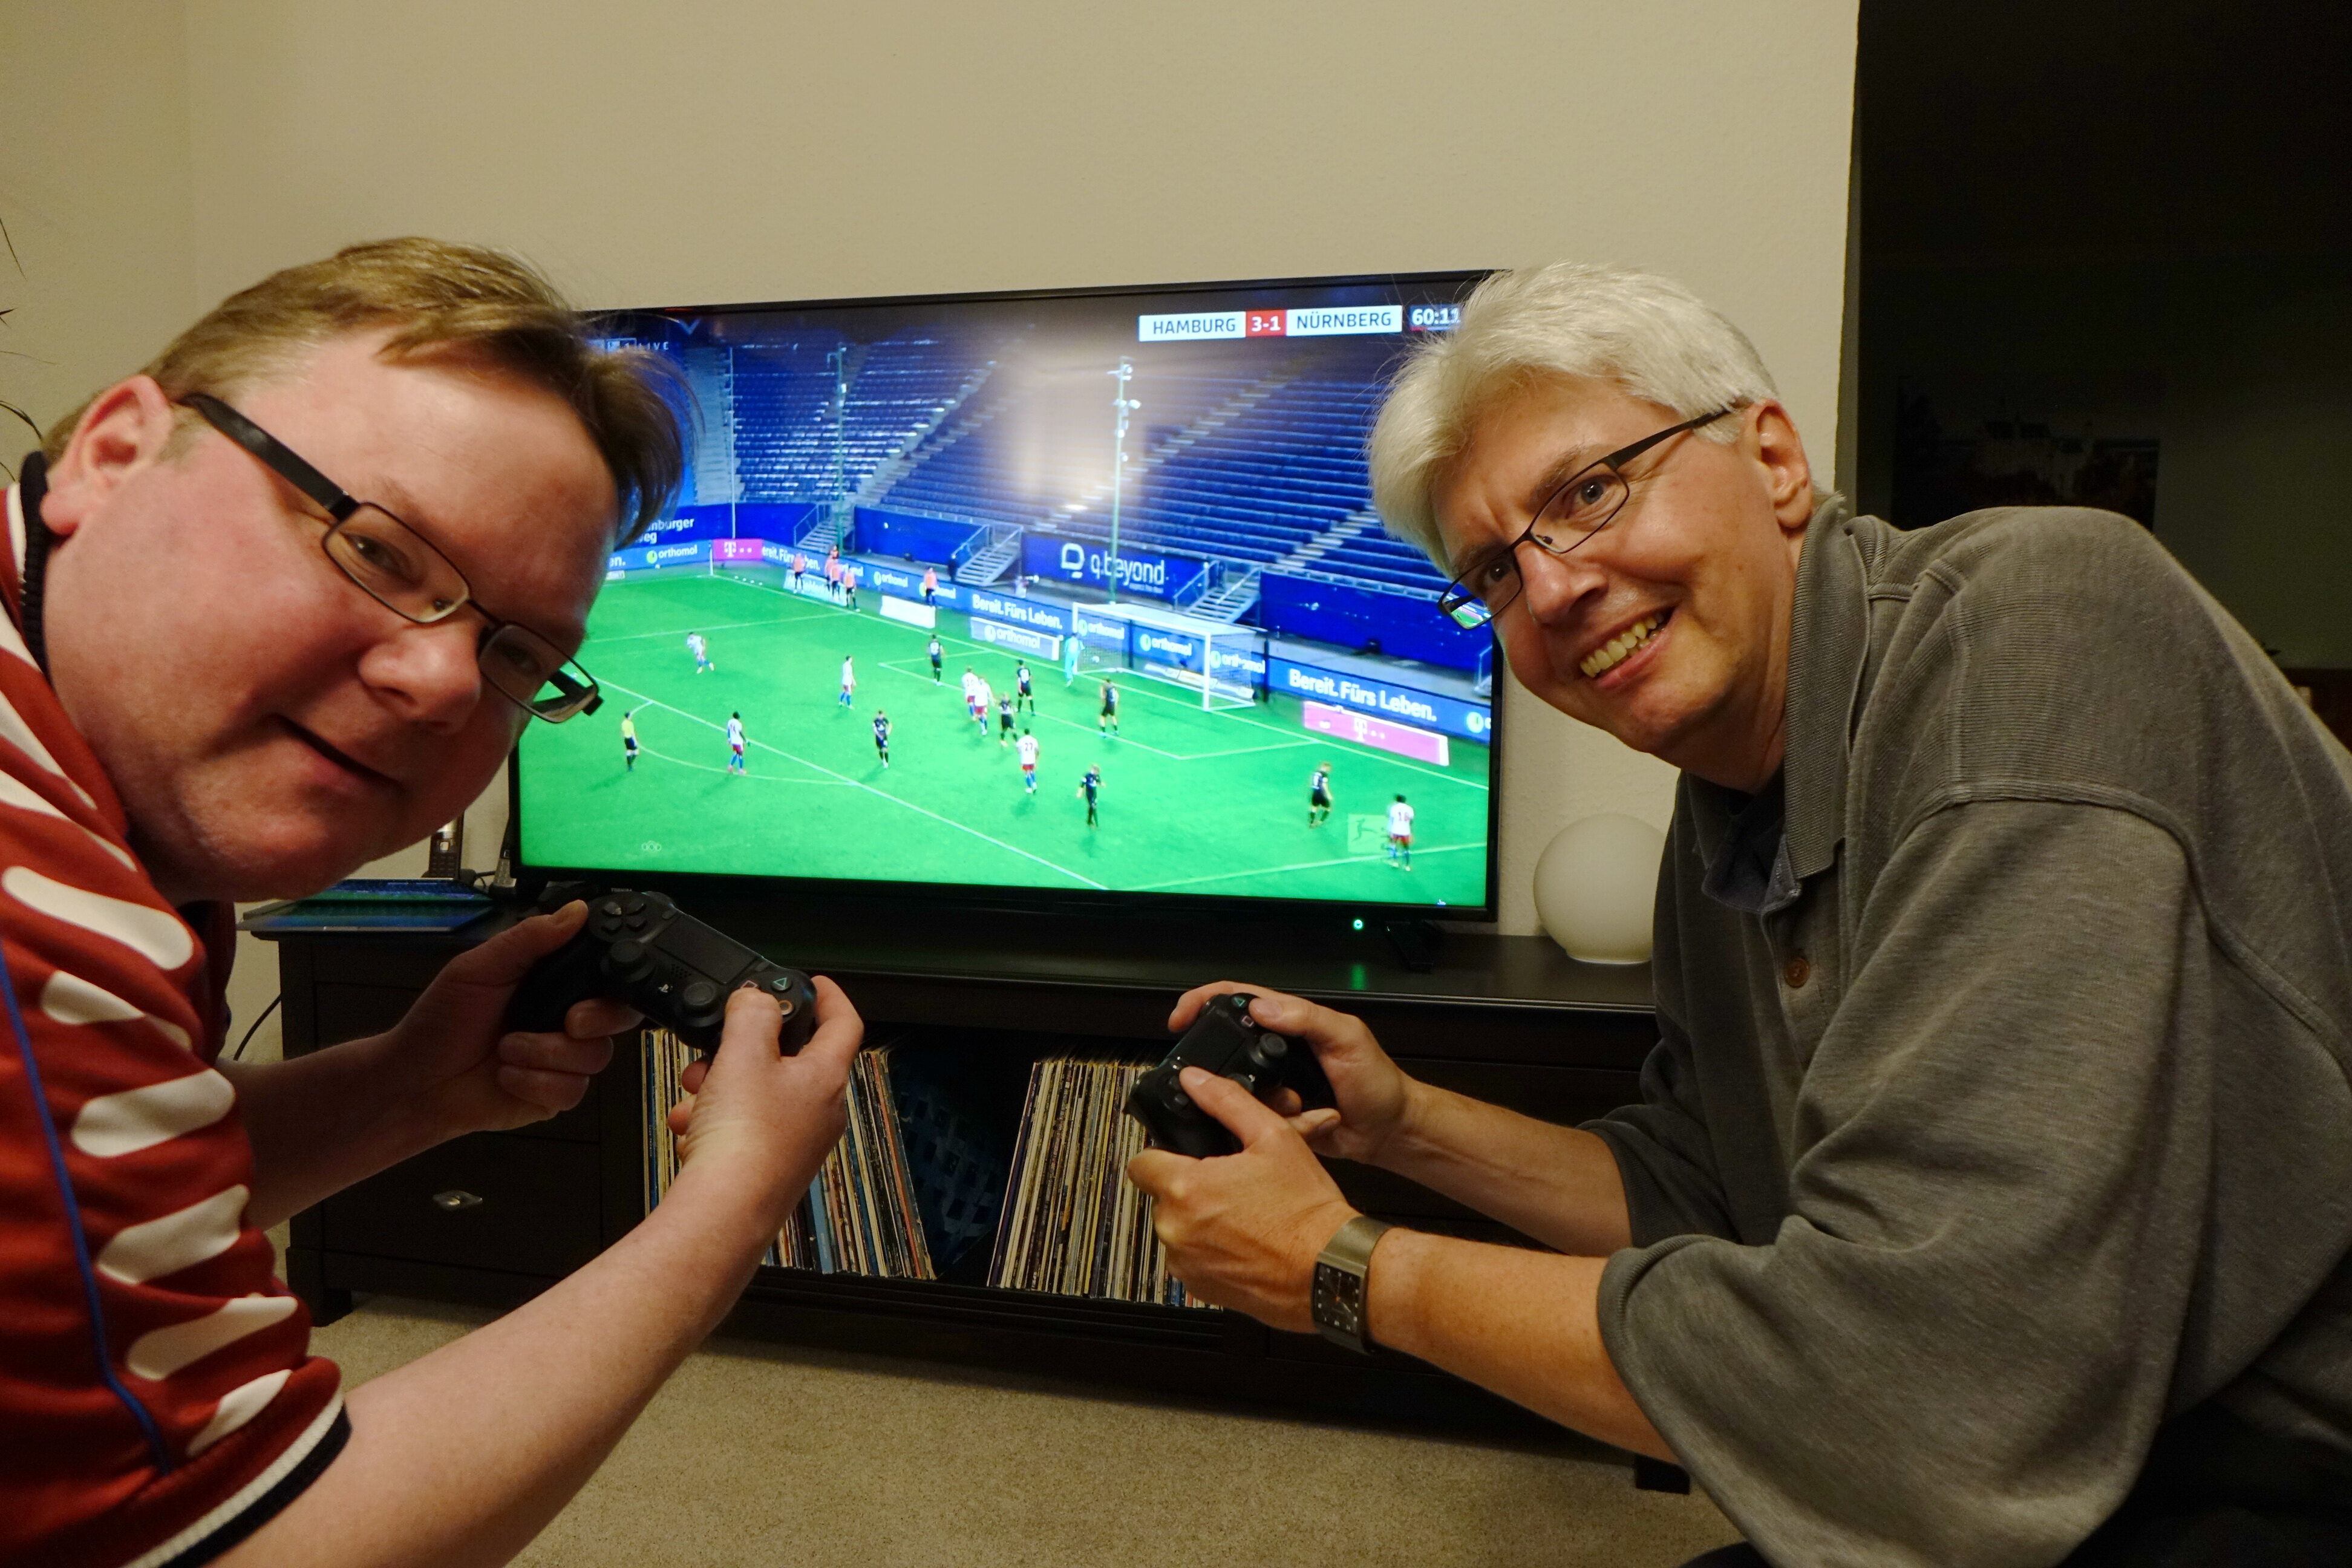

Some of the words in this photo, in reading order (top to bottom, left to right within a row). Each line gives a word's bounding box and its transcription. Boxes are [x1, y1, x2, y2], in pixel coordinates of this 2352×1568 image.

[1153, 318, 1236, 335] HAMBURG
[1251, 316, 1281, 332] 3-1
[1296, 311, 1392, 329] NÜRNBERG
[658, 544, 697, 559] orthomol
[1004, 602, 1027, 621] Fürs
[1028, 607, 1062, 629] Leben.
[996, 628, 1040, 649] orthomol
[1151, 637, 1192, 656] orthomol
[1290, 668, 1339, 697] Bereit.
[1340, 681, 1376, 707] Fürs
[1380, 690, 1437, 722] Leben.
